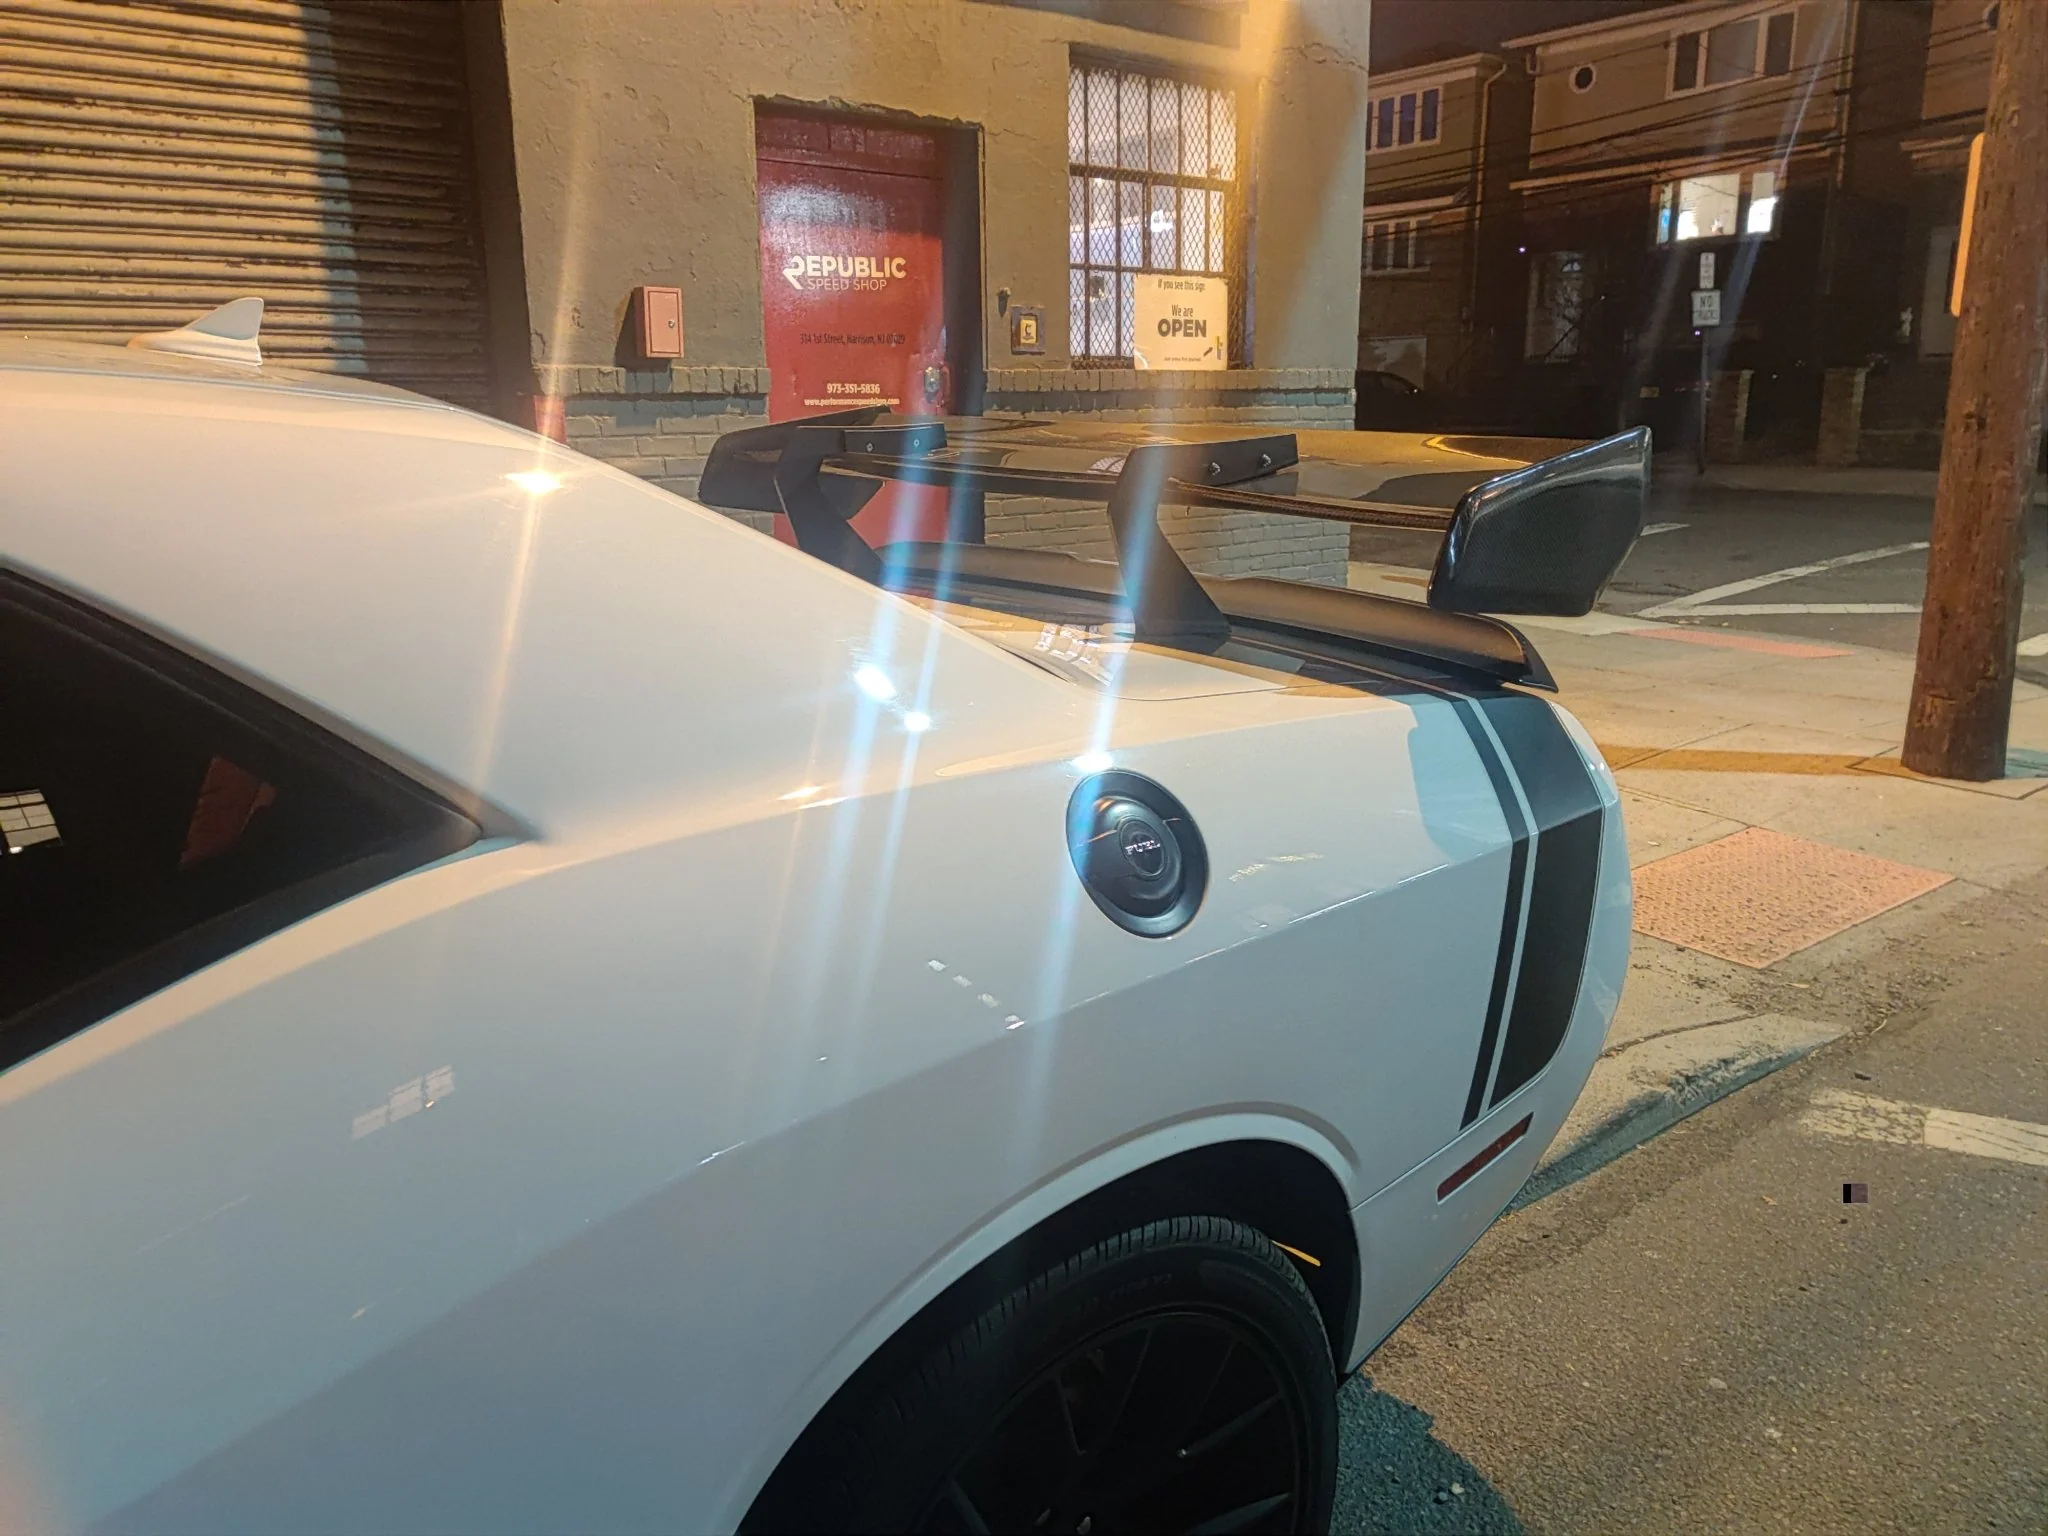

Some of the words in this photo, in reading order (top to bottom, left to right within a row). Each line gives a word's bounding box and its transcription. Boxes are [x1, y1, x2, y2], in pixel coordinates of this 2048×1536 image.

[782, 255, 907, 290] REPUBLIC
[807, 278, 850, 290] SPEED
[853, 279, 888, 290] SHOP
[1163, 281, 1174, 290] you
[1174, 281, 1184, 290] see
[1184, 280, 1194, 290] this
[1700, 295, 1714, 308] NO
[1171, 304, 1182, 316] We
[1182, 307, 1194, 317] are
[1157, 318, 1207, 337] OPEN
[826, 383, 880, 394] 973-351-5836
